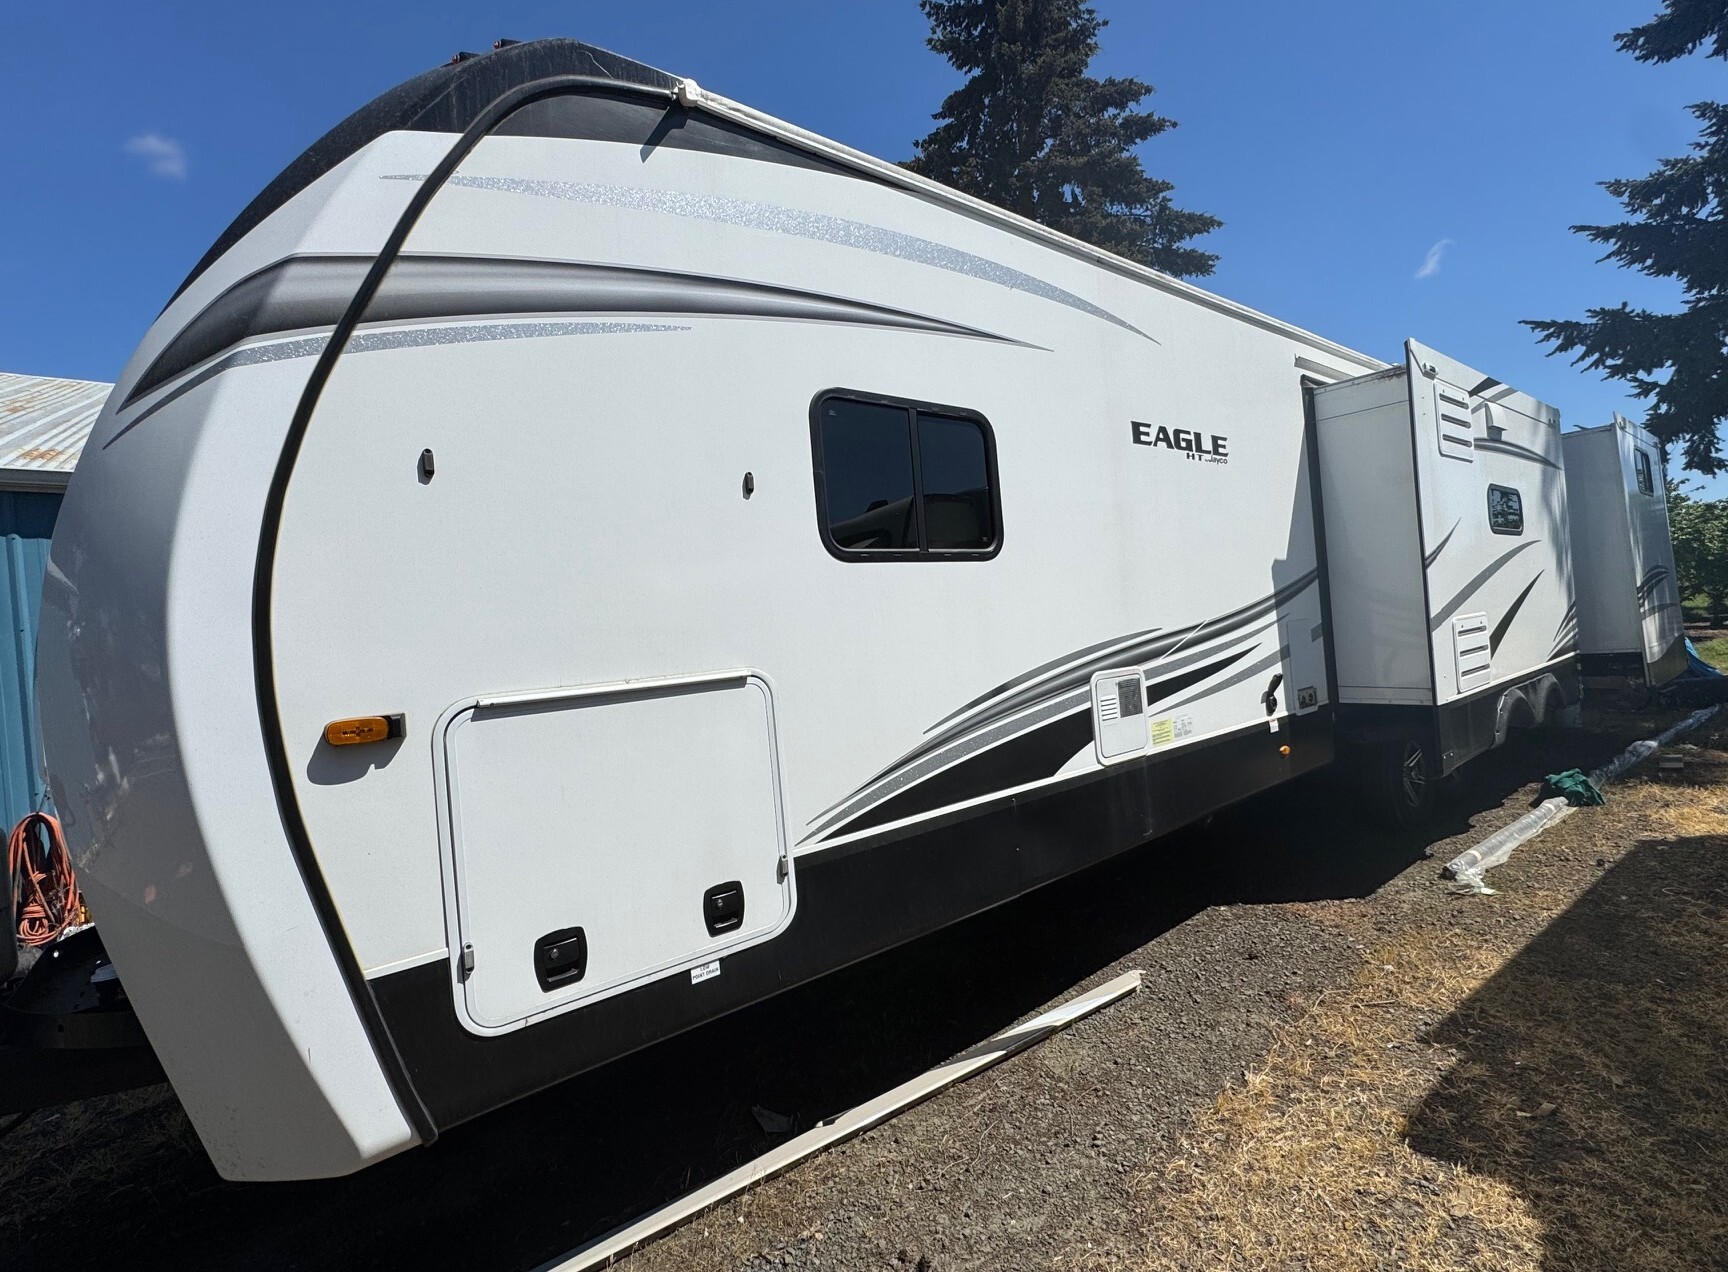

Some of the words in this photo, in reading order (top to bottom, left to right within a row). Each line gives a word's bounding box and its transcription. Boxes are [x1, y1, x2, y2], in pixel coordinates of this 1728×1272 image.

[1130, 420, 1229, 457] EAGLE
[692, 972, 705, 980] POINT
[705, 967, 719, 976] DRAIN
